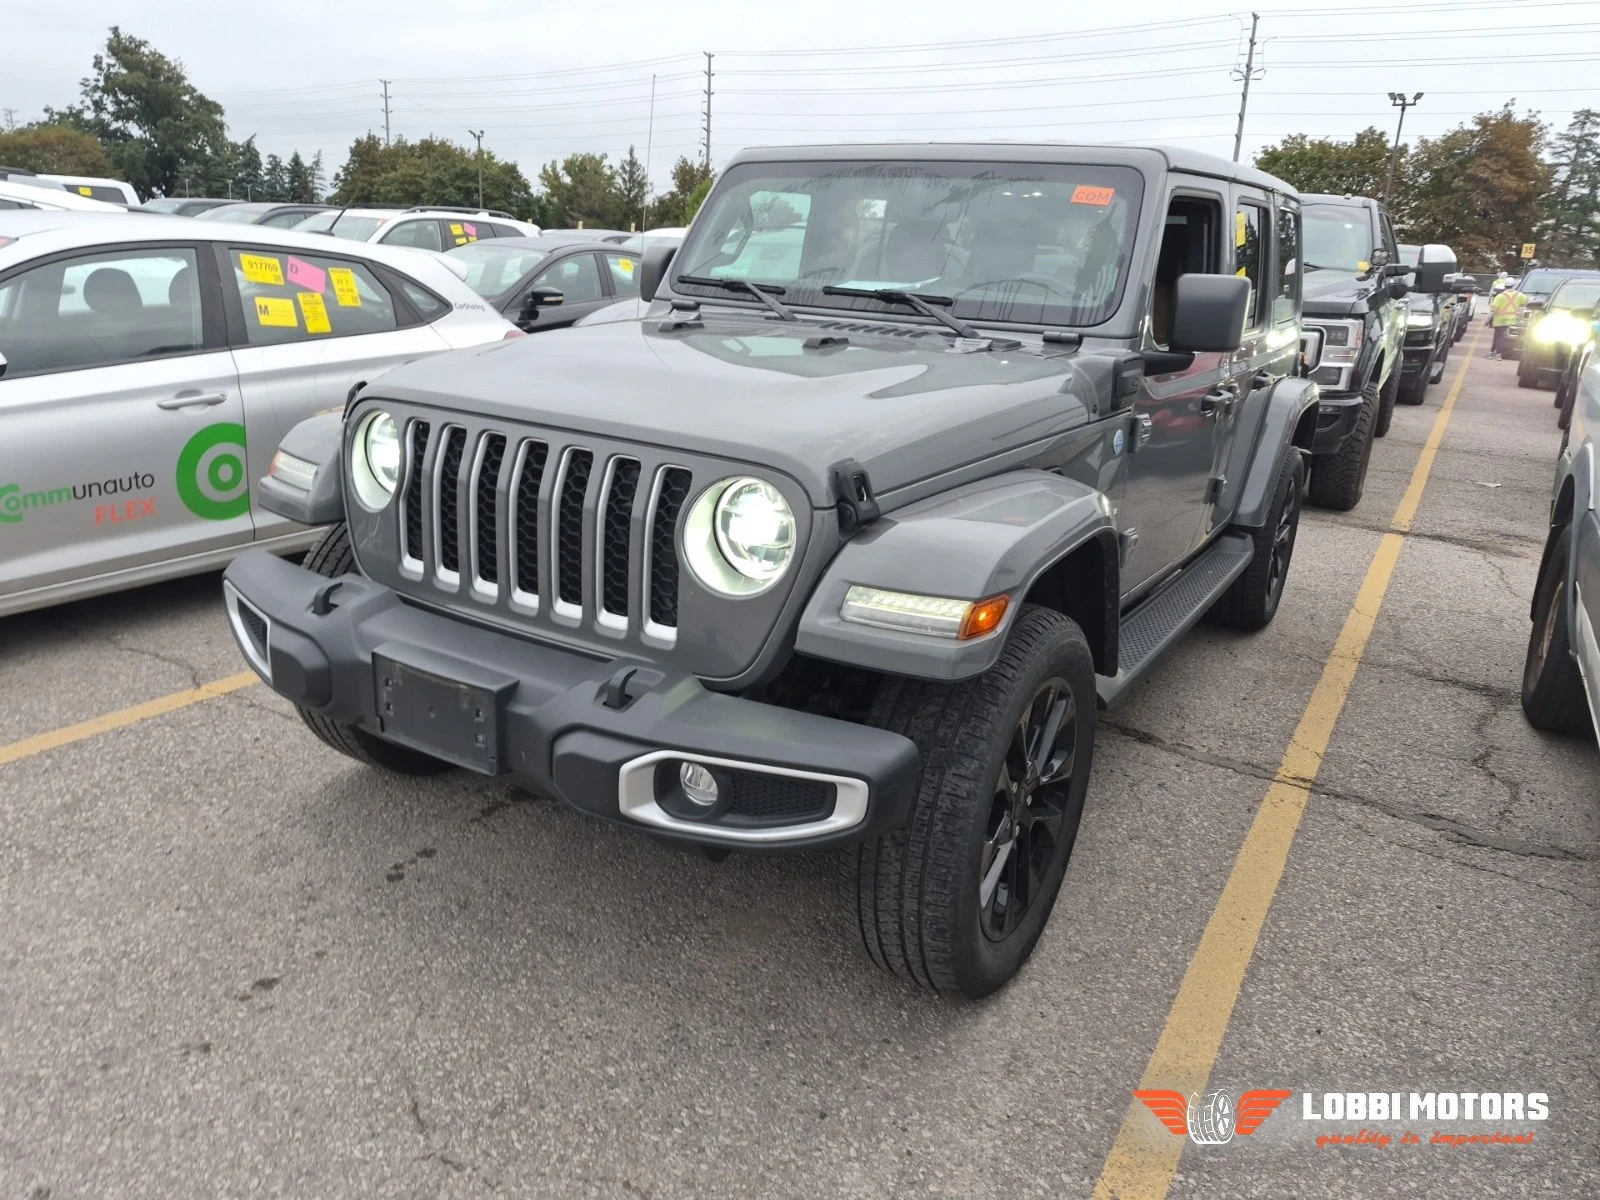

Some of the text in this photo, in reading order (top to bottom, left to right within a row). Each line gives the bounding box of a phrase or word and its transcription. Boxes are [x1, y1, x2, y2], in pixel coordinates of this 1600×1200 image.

[1075, 191, 1111, 202] COM
[258, 305, 270, 316] M
[95, 496, 157, 527] FLEX
